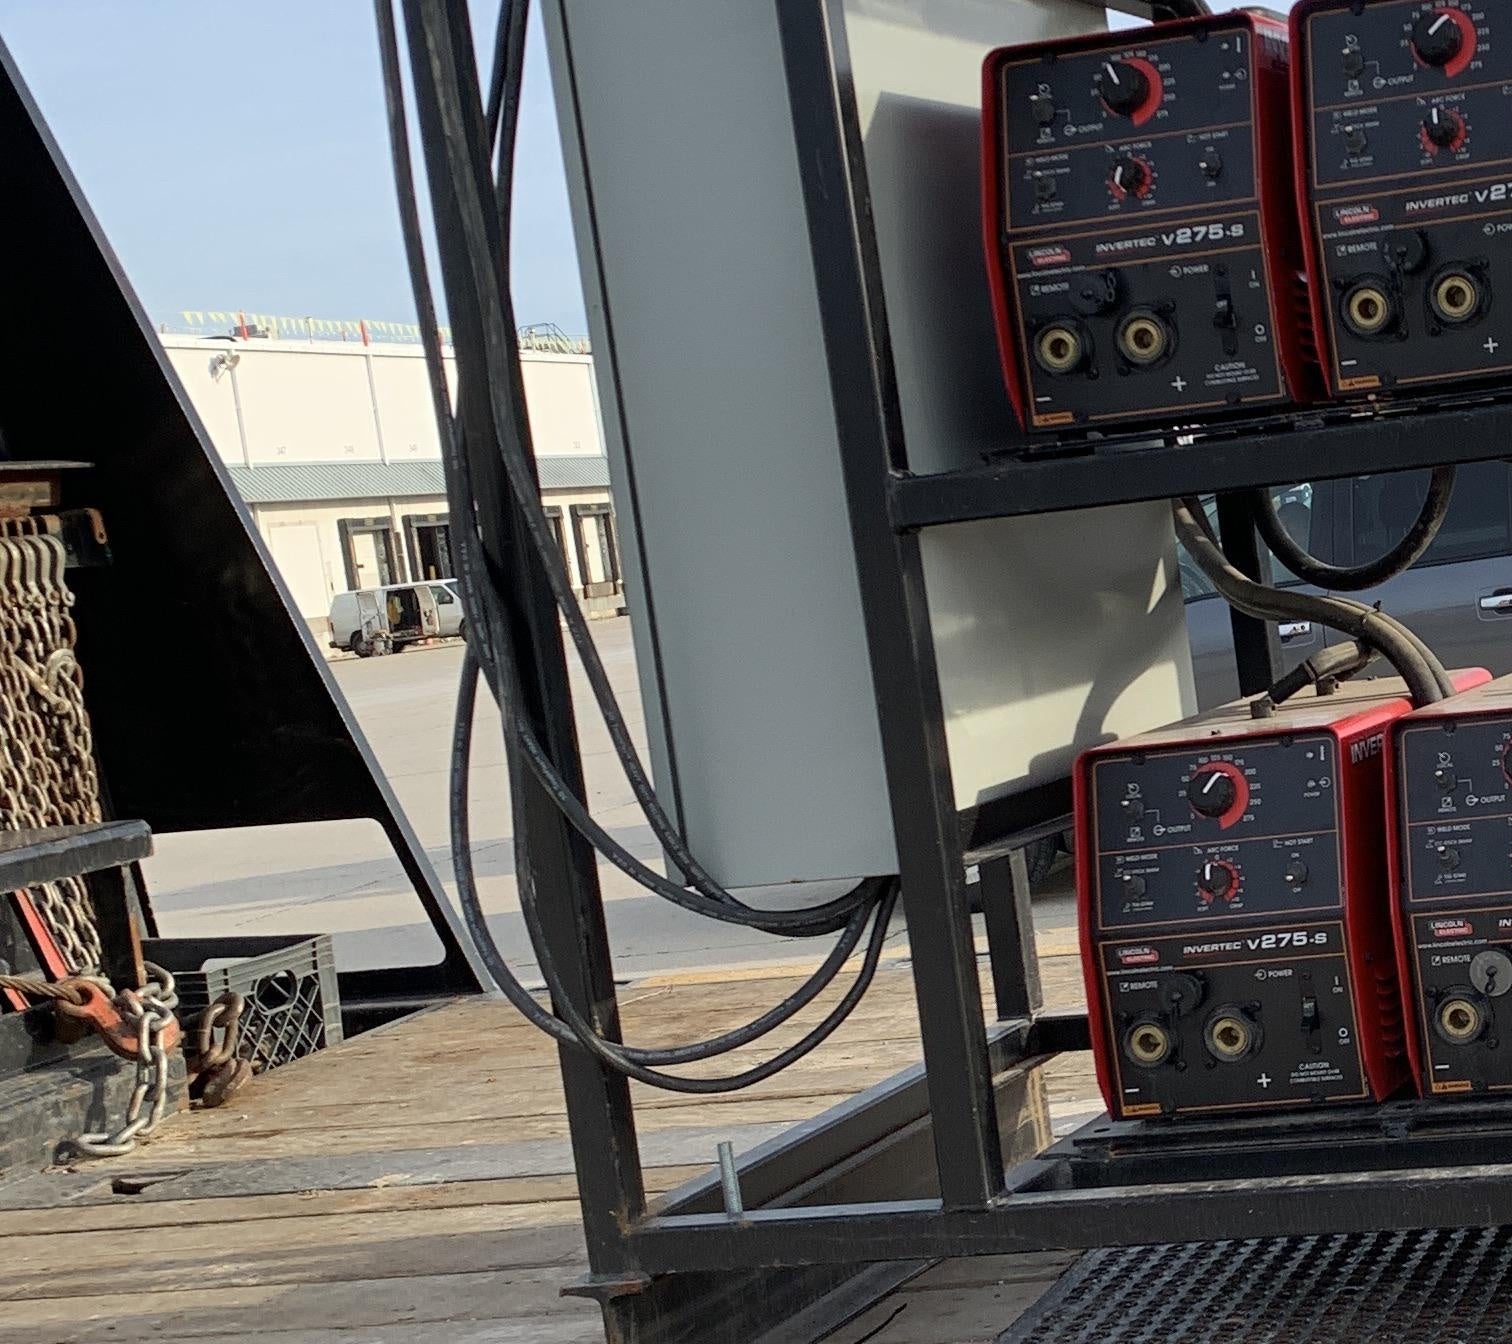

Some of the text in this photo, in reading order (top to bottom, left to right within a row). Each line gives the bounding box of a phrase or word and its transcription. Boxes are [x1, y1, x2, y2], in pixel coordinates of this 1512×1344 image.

[1406, 194, 1469, 212] INVERTEC
[1096, 236, 1156, 253] INVERTEC
[1346, 242, 1378, 254] REMOTE
[1182, 264, 1210, 274] POWER
[1480, 796, 1506, 804] OUTPUT
[1167, 824, 1192, 834] OUTPUT
[1430, 920, 1464, 929] LINCOLN
[1183, 942, 1242, 954] INVERTEC
[1417, 938, 1488, 949] www.lincolnelectric.com
[1119, 948, 1150, 956] LINCOLN
[1442, 954, 1471, 964] REMOTE
[1268, 969, 1293, 978] POWER
[1130, 981, 1158, 991] REMOTE
